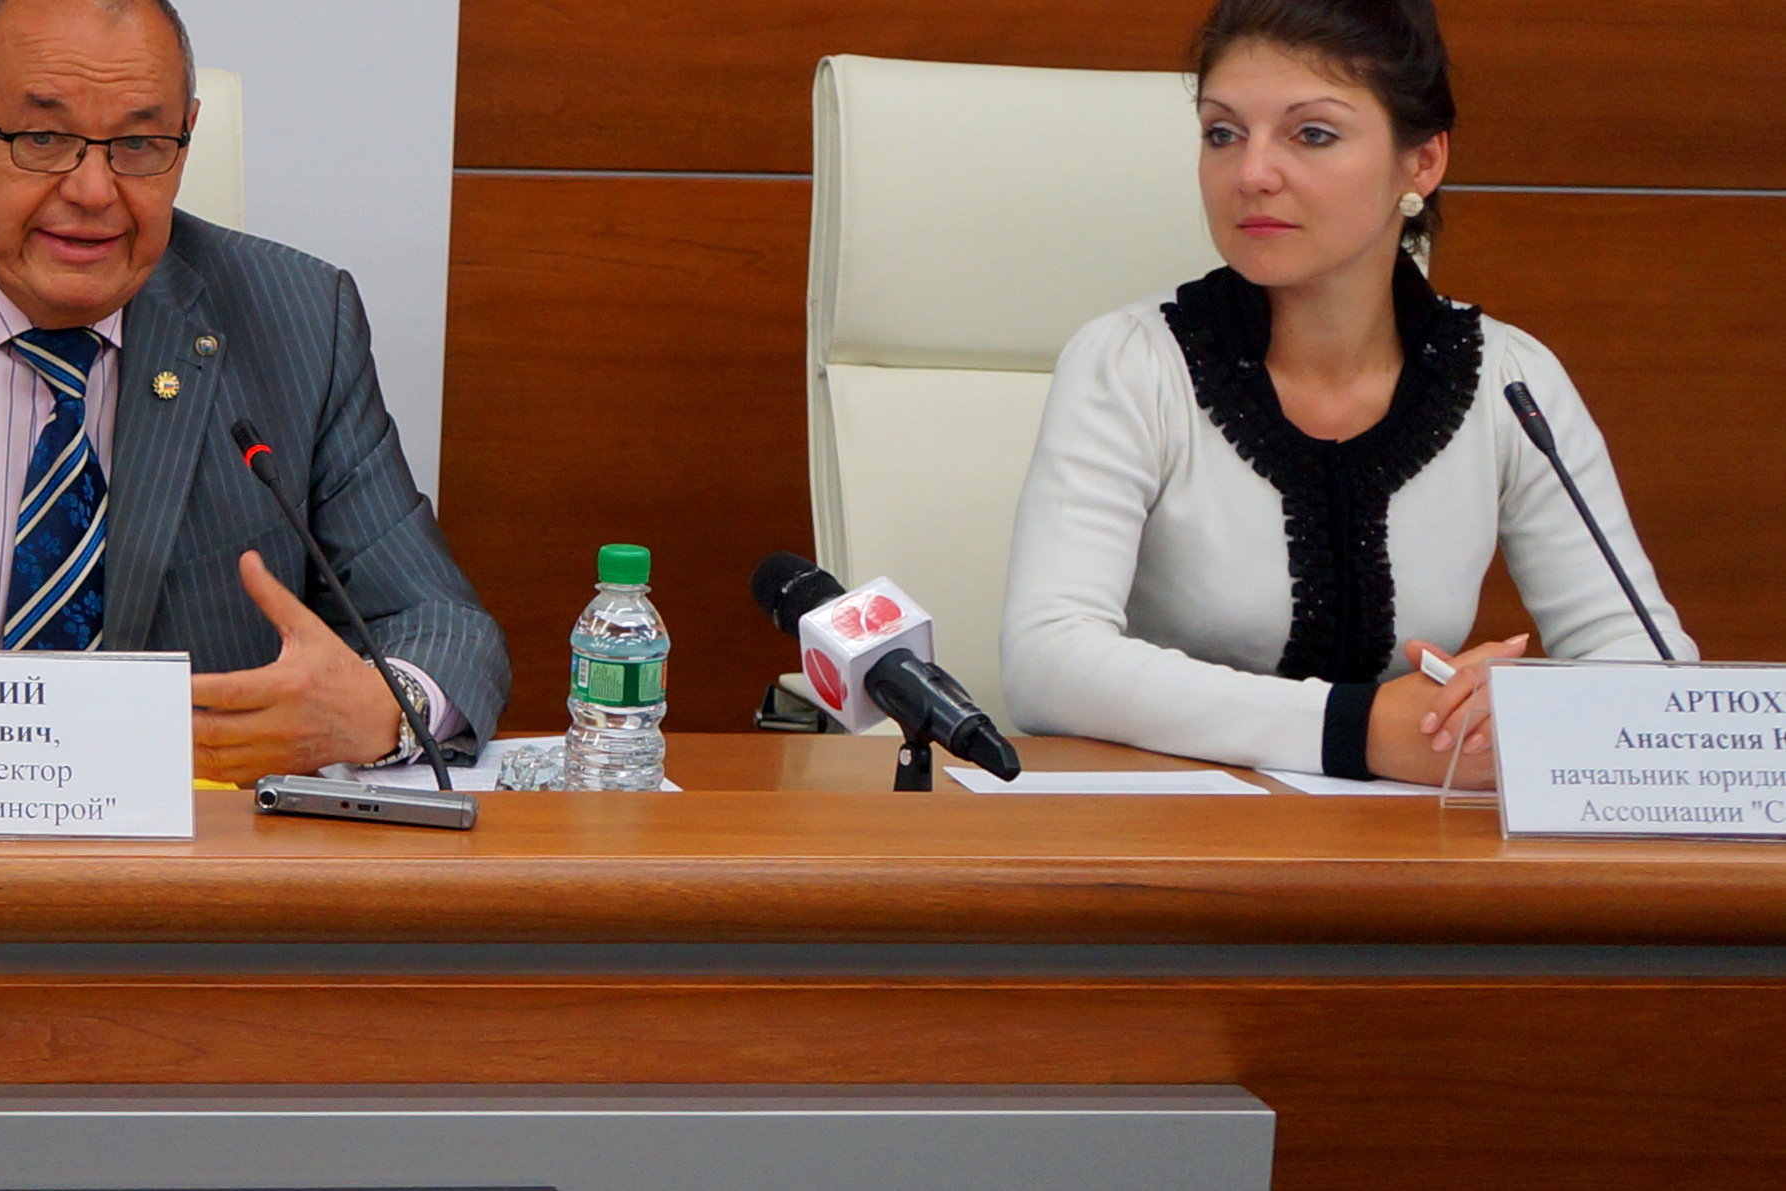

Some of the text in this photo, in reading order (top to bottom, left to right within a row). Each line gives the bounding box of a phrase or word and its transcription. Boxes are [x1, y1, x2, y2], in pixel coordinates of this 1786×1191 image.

[1614, 727, 1764, 750] Анастасия
[1550, 768, 1690, 787] начальник
[1581, 800, 1743, 823] Ассоциации
